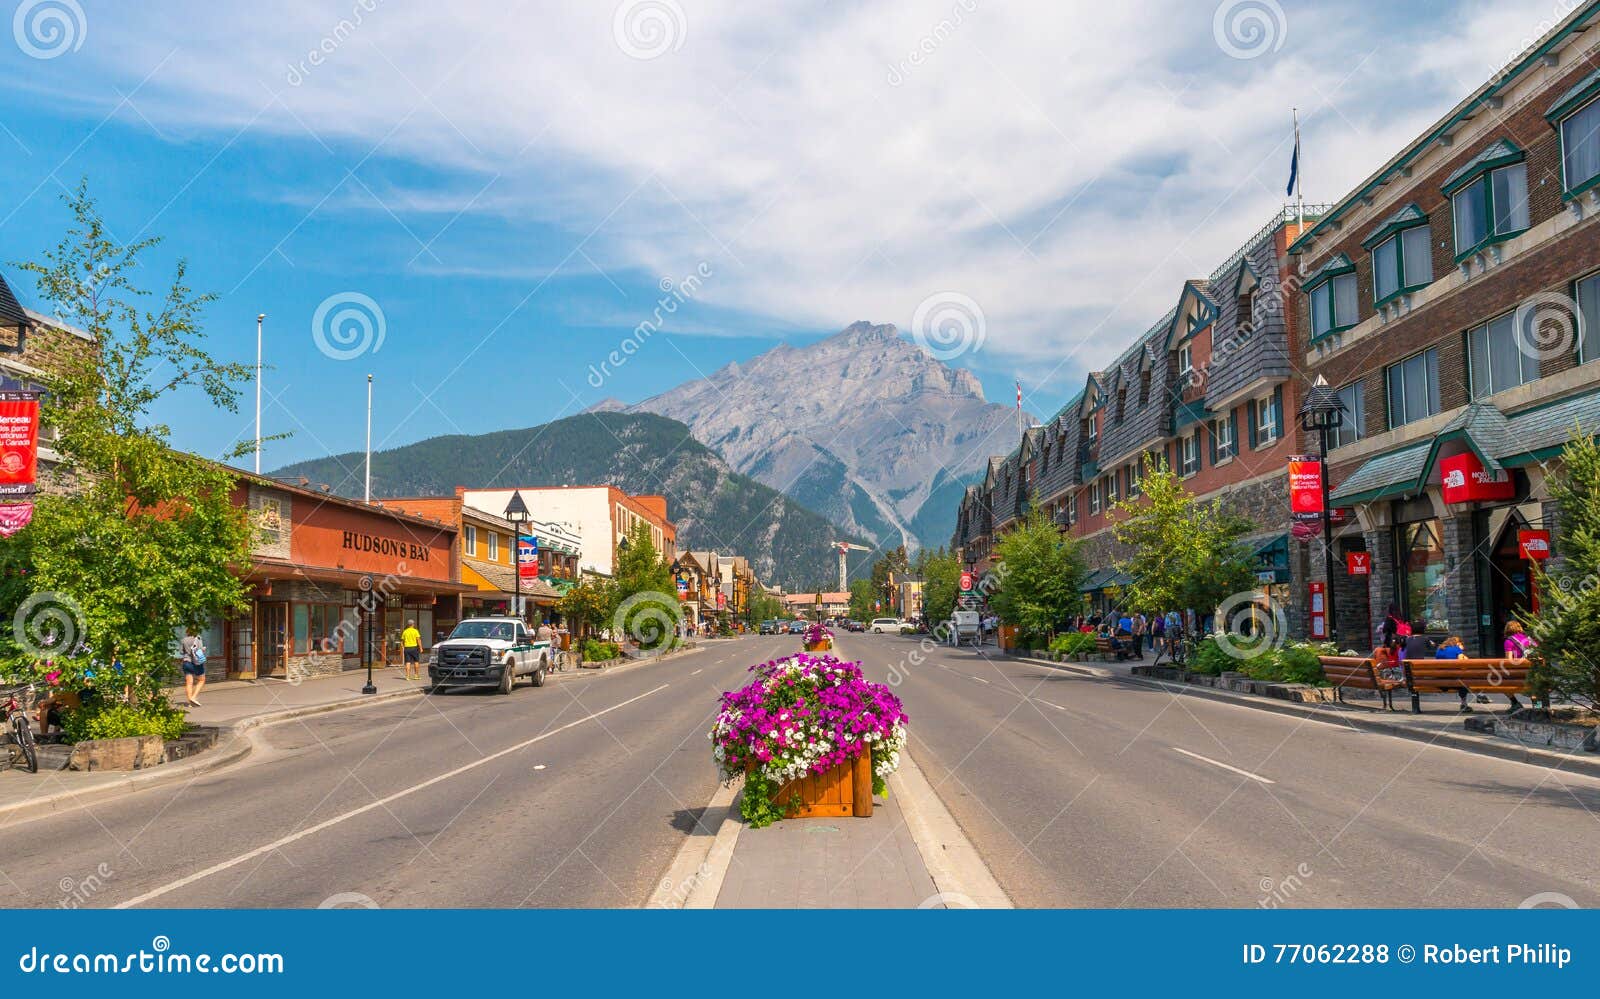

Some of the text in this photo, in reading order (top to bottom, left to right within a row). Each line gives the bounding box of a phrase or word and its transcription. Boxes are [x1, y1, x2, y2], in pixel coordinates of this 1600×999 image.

[0, 416, 31, 424] erceau
[0, 485, 26, 493] anada
[342, 531, 430, 562] HUDSON'S BAY
